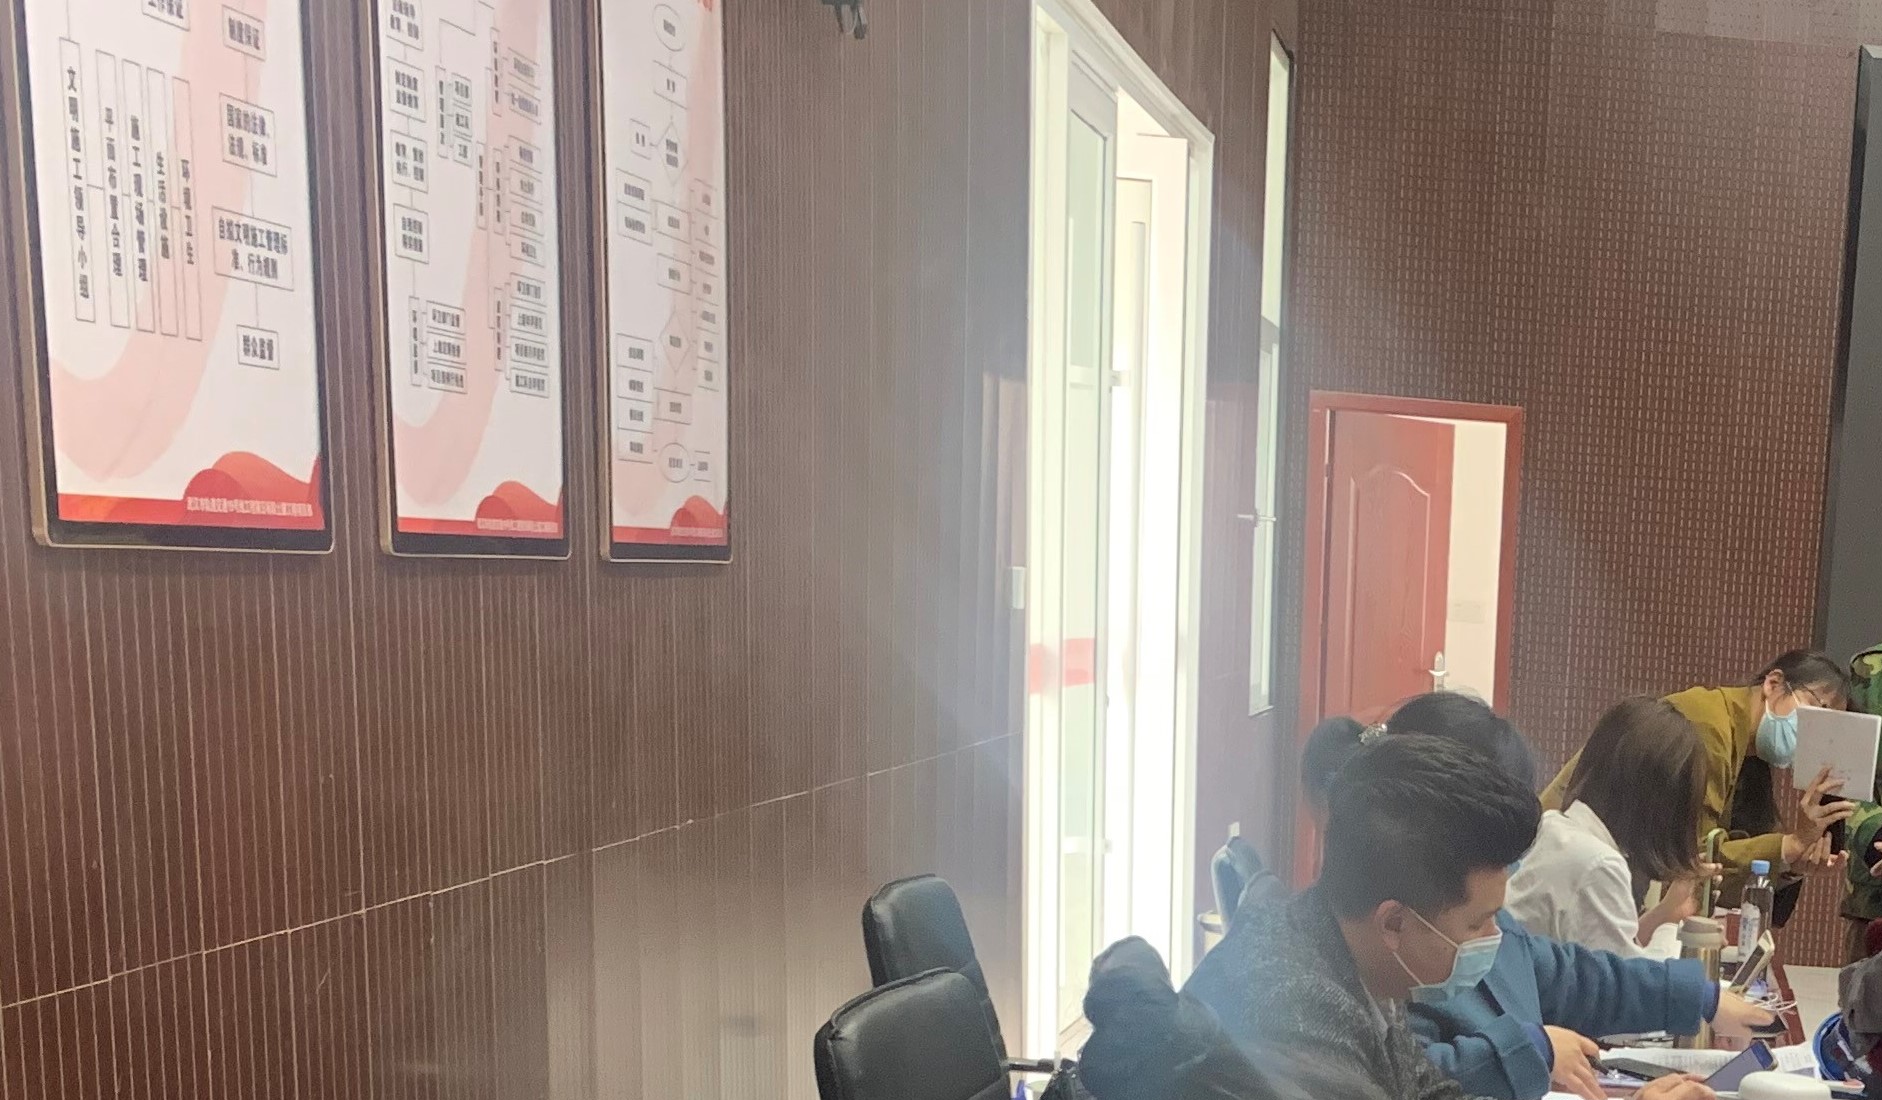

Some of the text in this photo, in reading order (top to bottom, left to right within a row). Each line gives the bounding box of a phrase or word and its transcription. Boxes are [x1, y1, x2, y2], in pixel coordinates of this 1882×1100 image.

[66, 66, 90, 299] 文明施工领导小组
